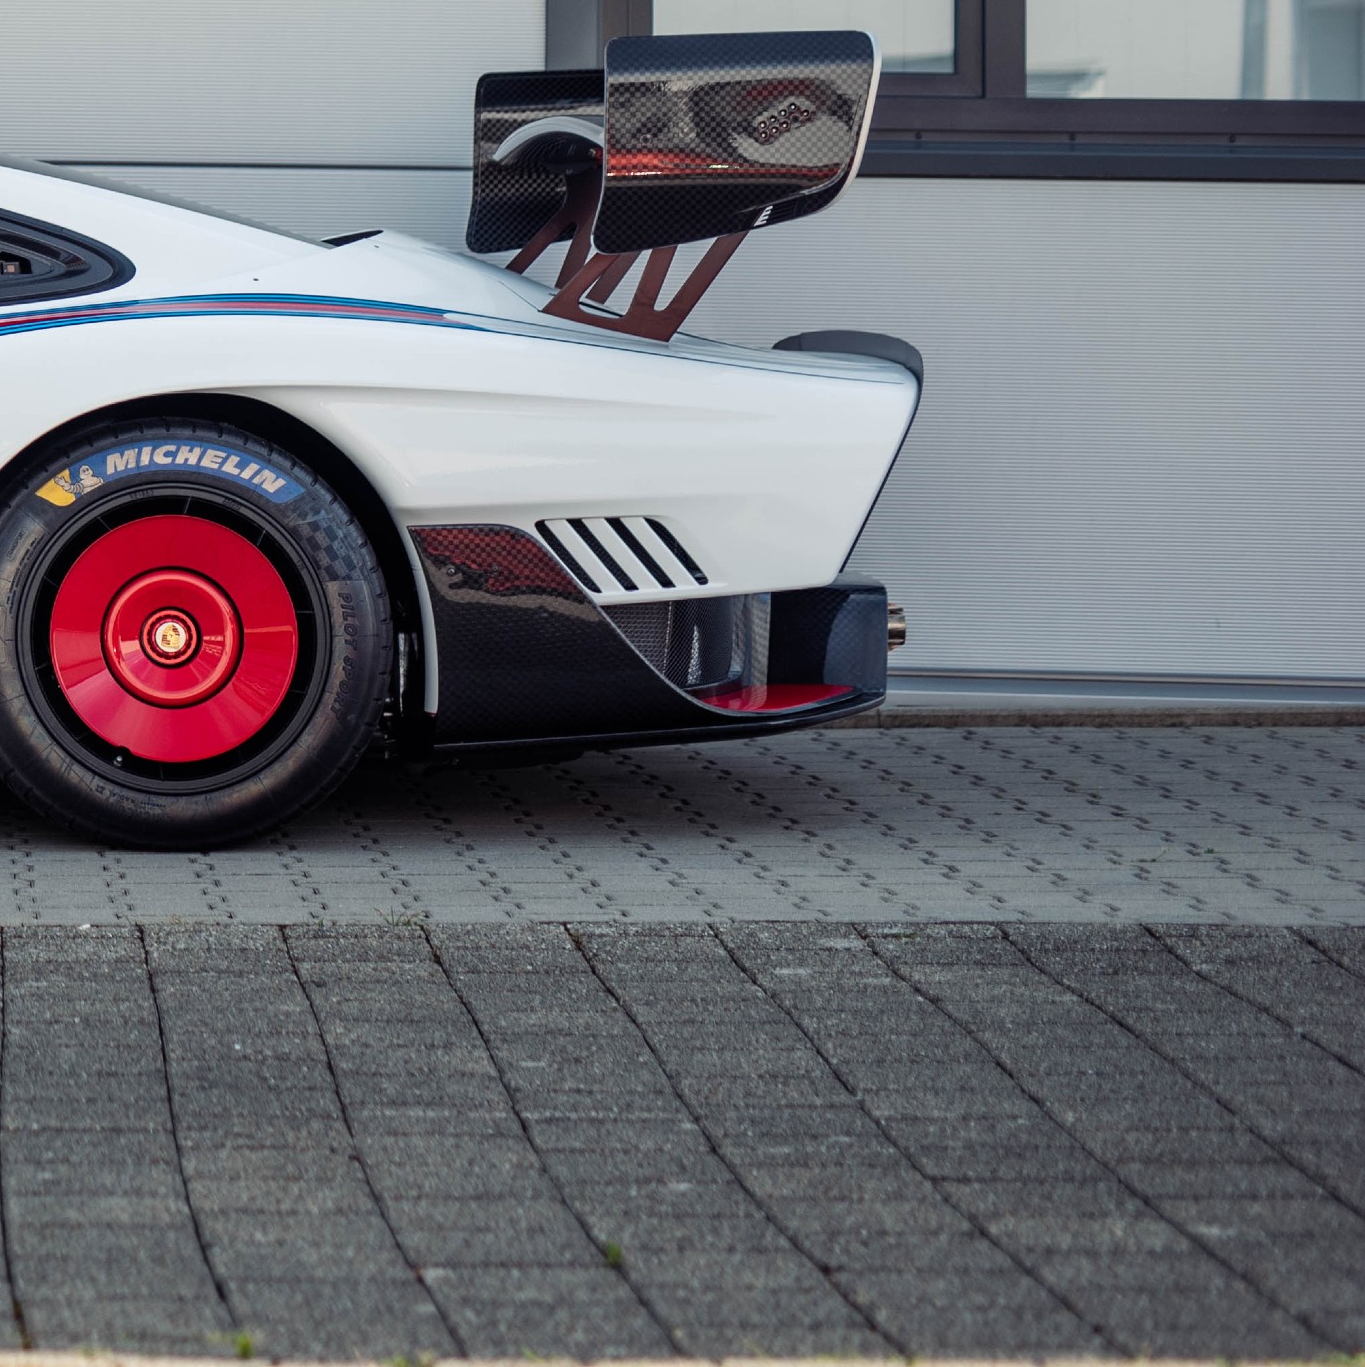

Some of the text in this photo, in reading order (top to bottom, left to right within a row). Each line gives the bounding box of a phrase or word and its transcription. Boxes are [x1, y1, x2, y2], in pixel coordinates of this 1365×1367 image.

[106, 444, 287, 494] MICHELIN
[330, 592, 358, 721] PILOT SPORT
